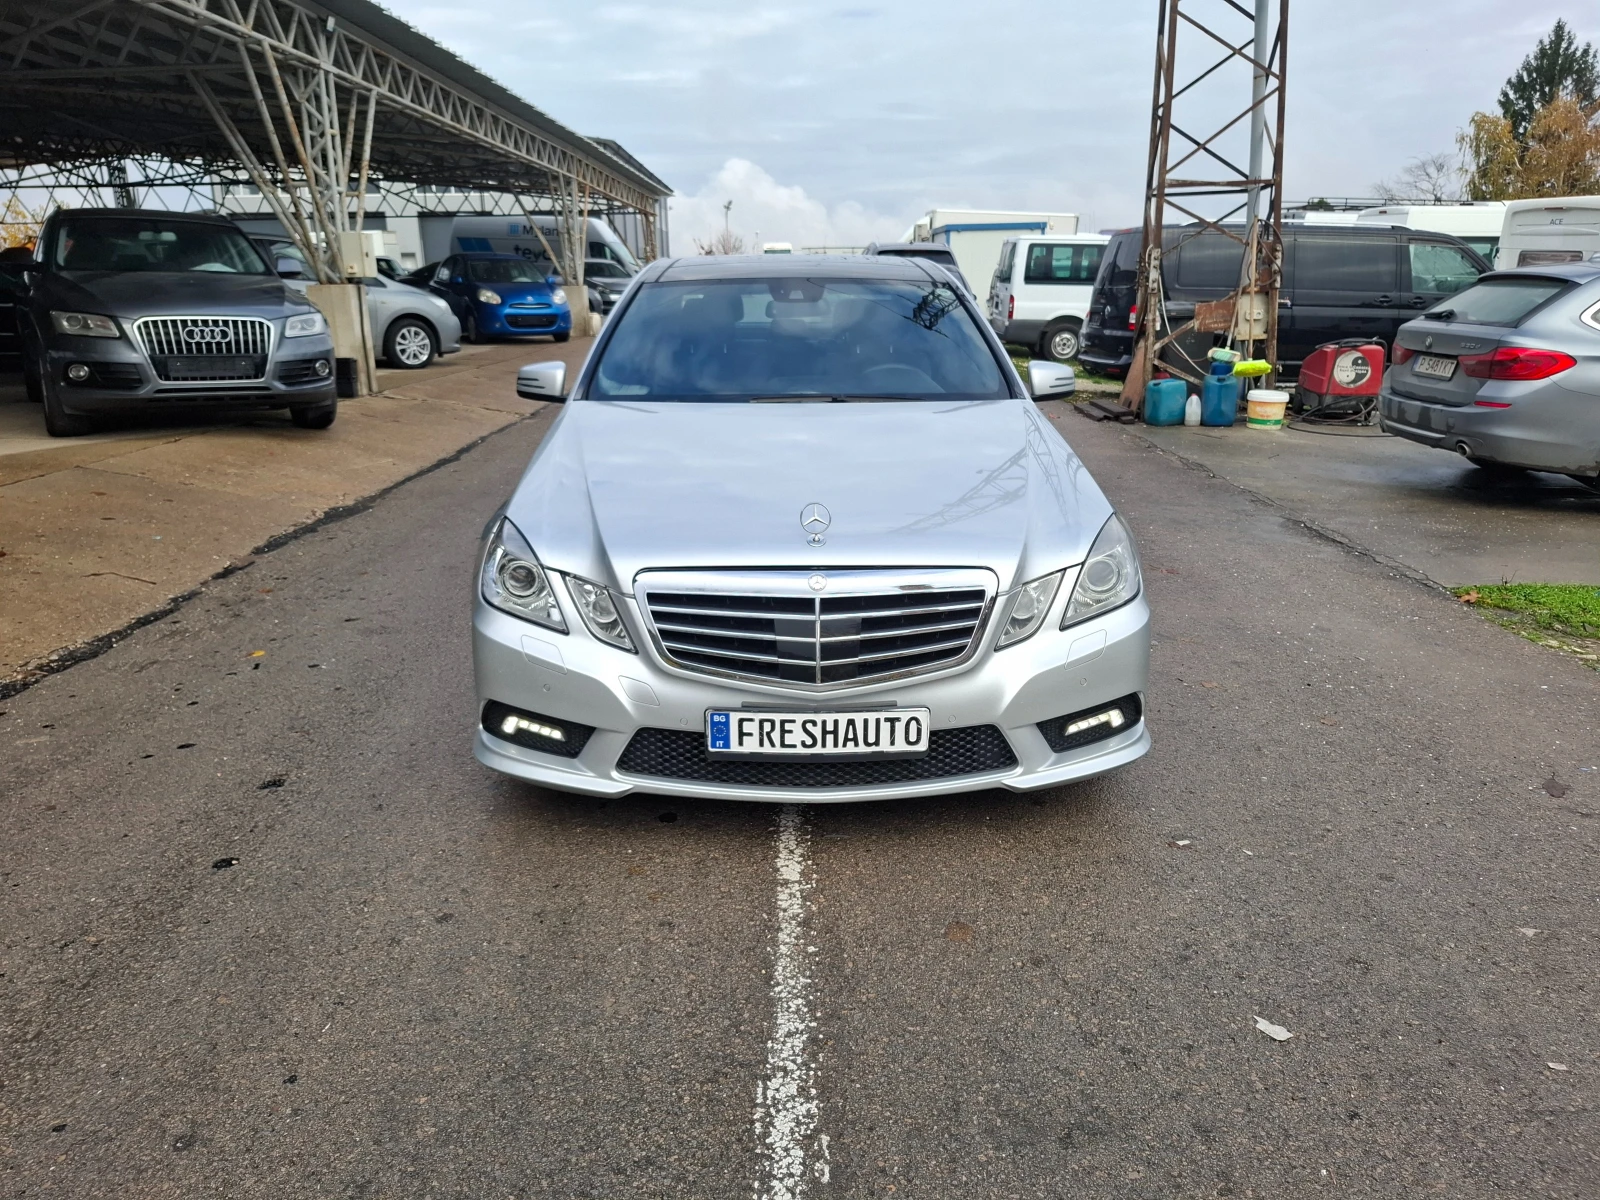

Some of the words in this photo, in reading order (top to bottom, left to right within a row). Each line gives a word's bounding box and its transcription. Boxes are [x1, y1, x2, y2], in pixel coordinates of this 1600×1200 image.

[1418, 357, 1426, 370] P
[713, 715, 726, 723] BG
[737, 716, 922, 749] FRESHAUTO
[715, 740, 724, 748] IT
